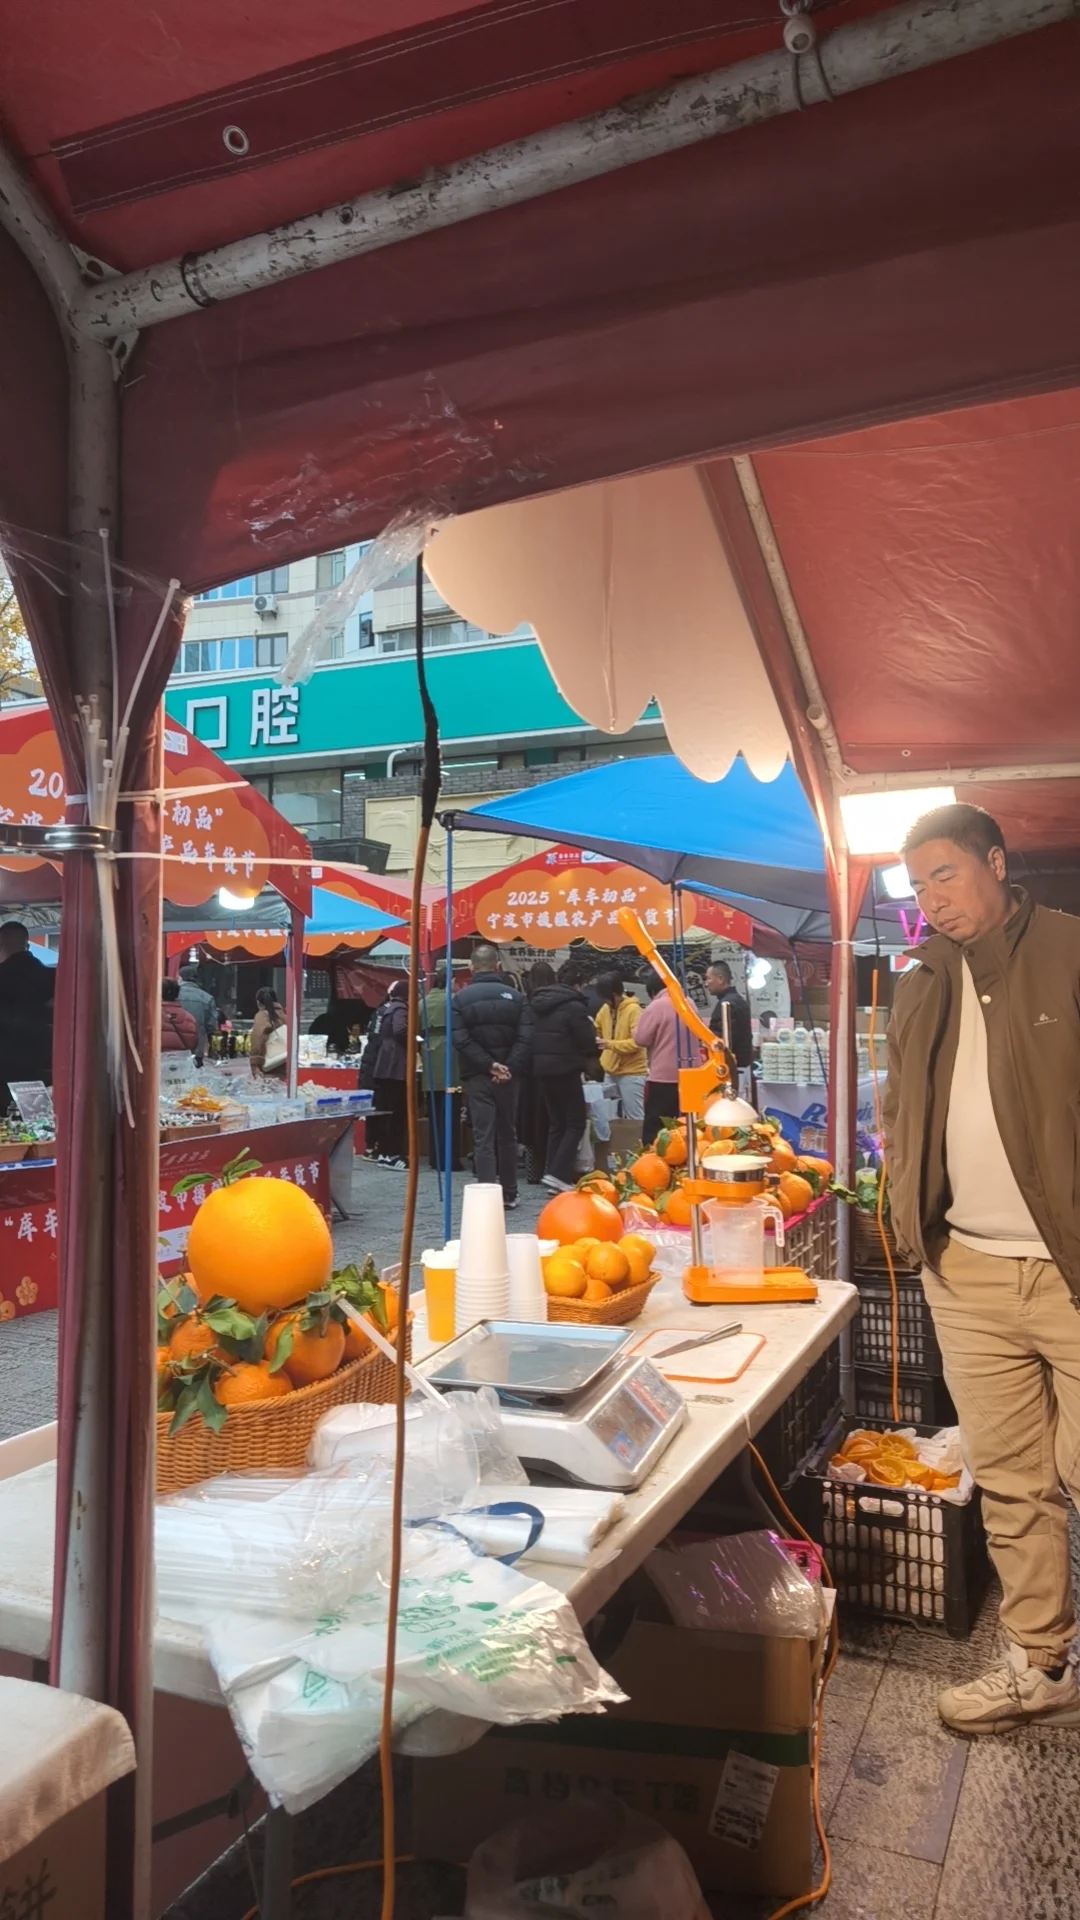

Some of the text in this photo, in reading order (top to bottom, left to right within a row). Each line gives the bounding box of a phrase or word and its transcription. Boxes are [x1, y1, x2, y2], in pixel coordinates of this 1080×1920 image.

[186, 687, 298, 748] 口腔
[163, 800, 223, 830] 初品”
[507, 891, 549, 906] 2025
[487, 908, 679, 930] 宁波市援疆农产品货节
